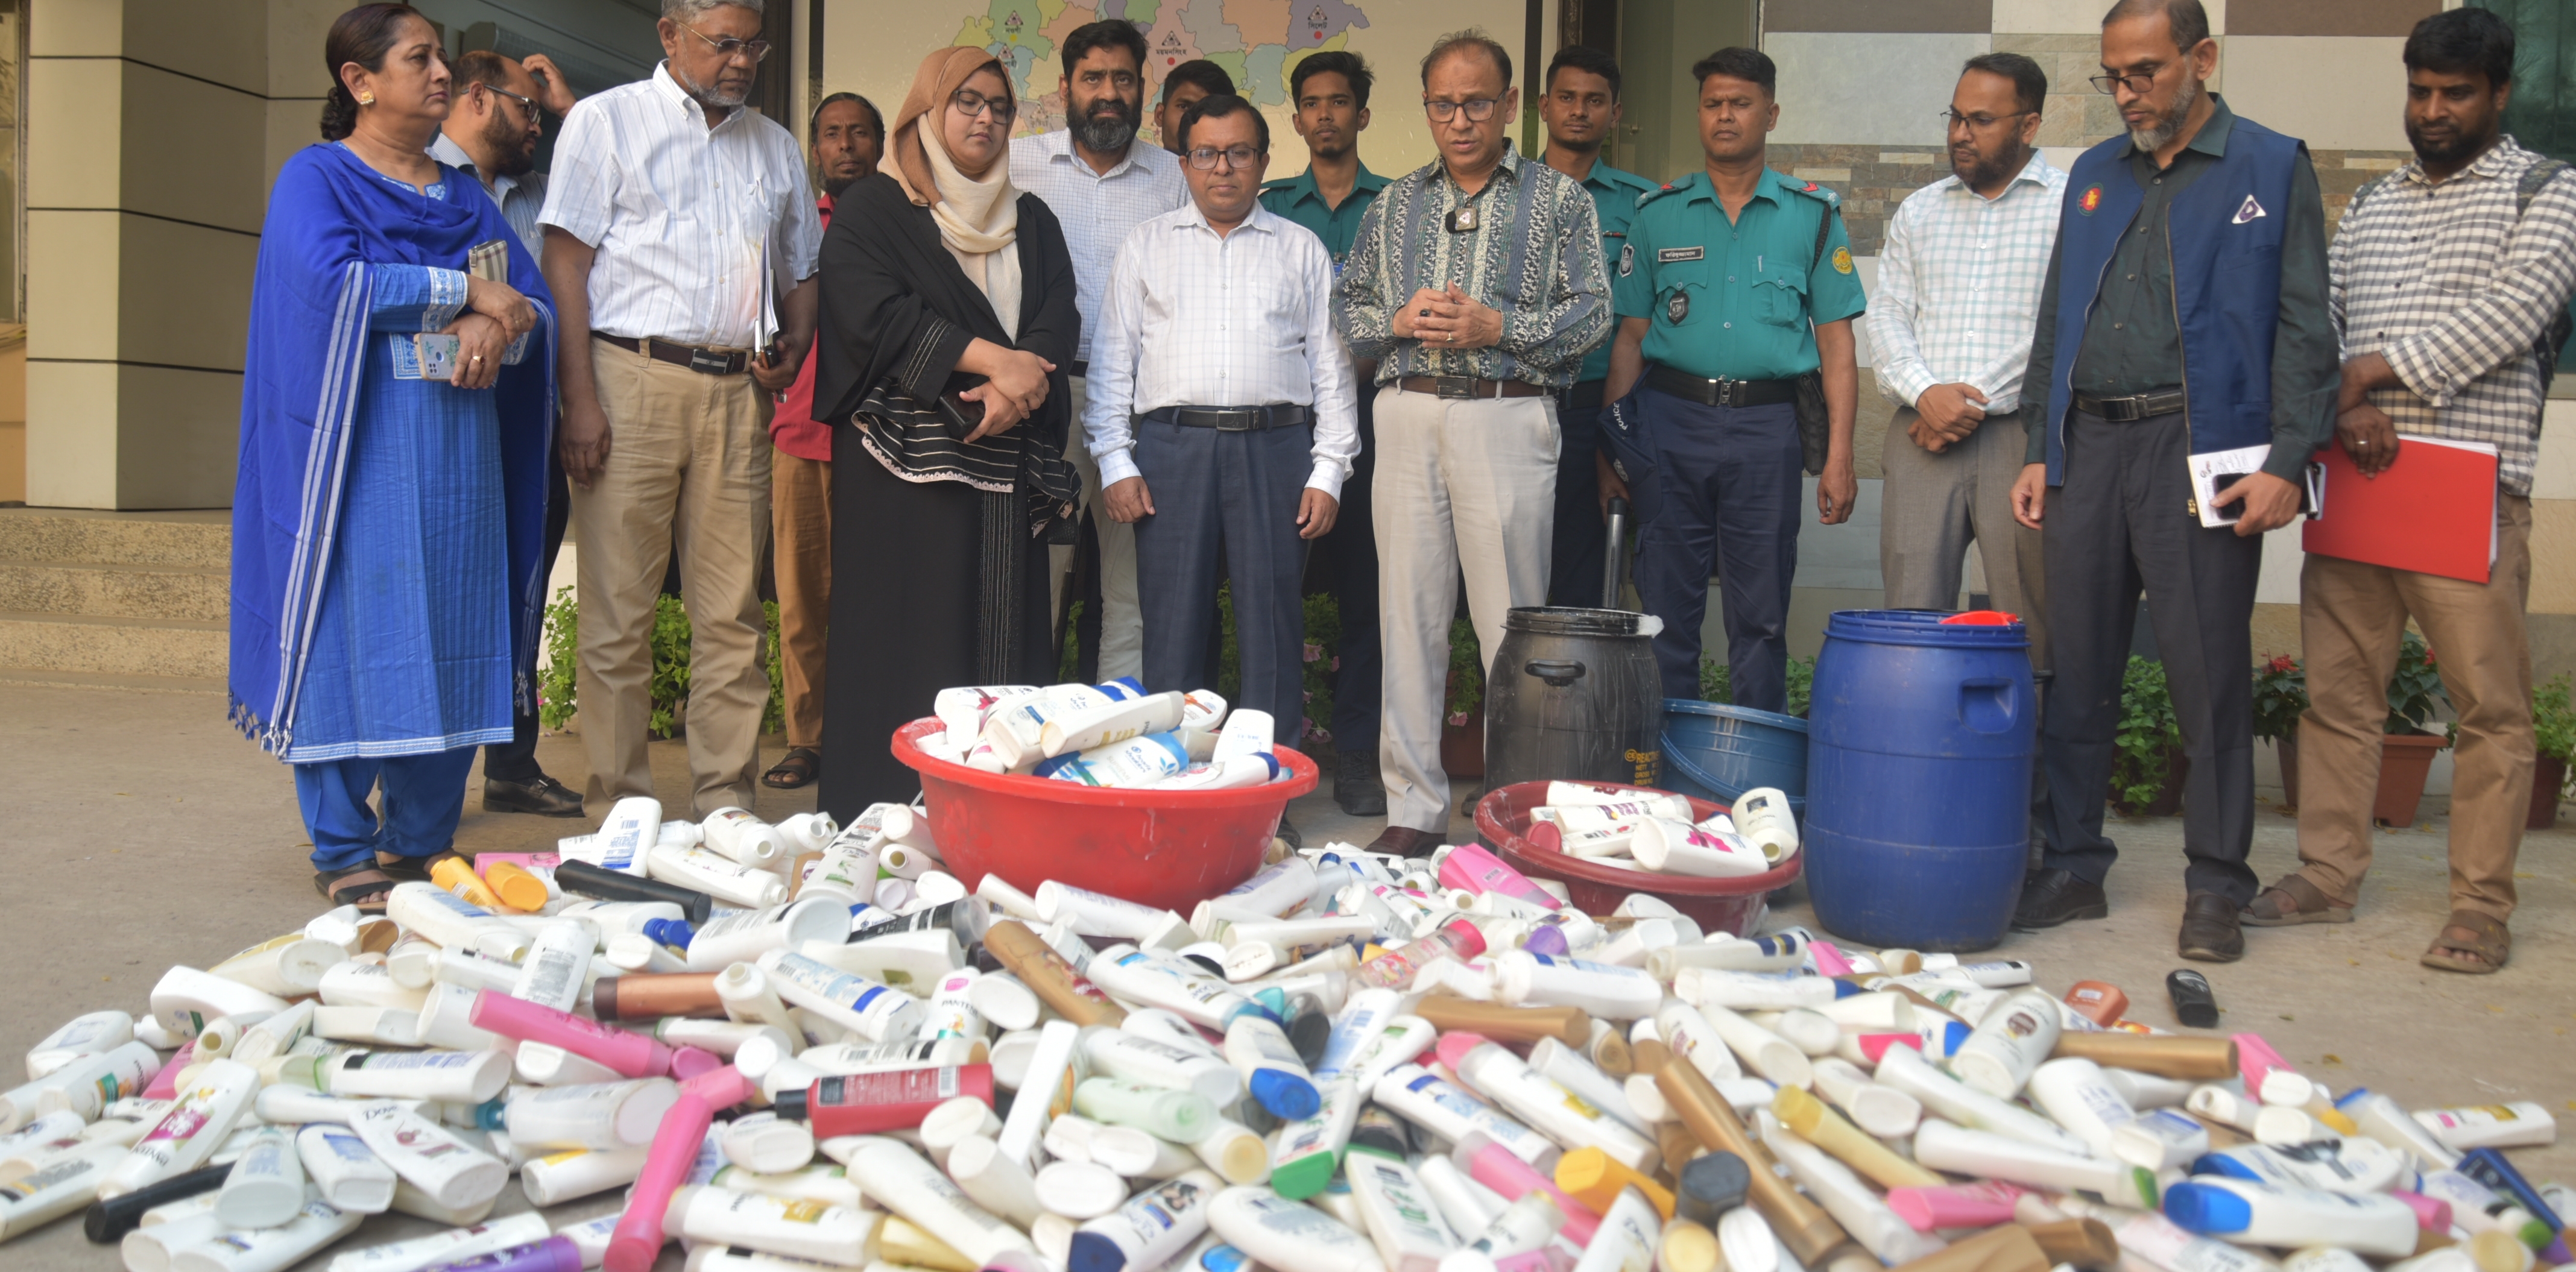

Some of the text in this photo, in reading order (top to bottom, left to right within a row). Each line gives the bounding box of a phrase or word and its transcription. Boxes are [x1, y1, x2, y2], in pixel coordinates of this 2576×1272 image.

[1308, 20, 1327, 30] সিলেট
[1613, 402, 1629, 430] POLICE
[1125, 749, 1147, 773] shoulders
[363, 1106, 397, 1121] Dove
